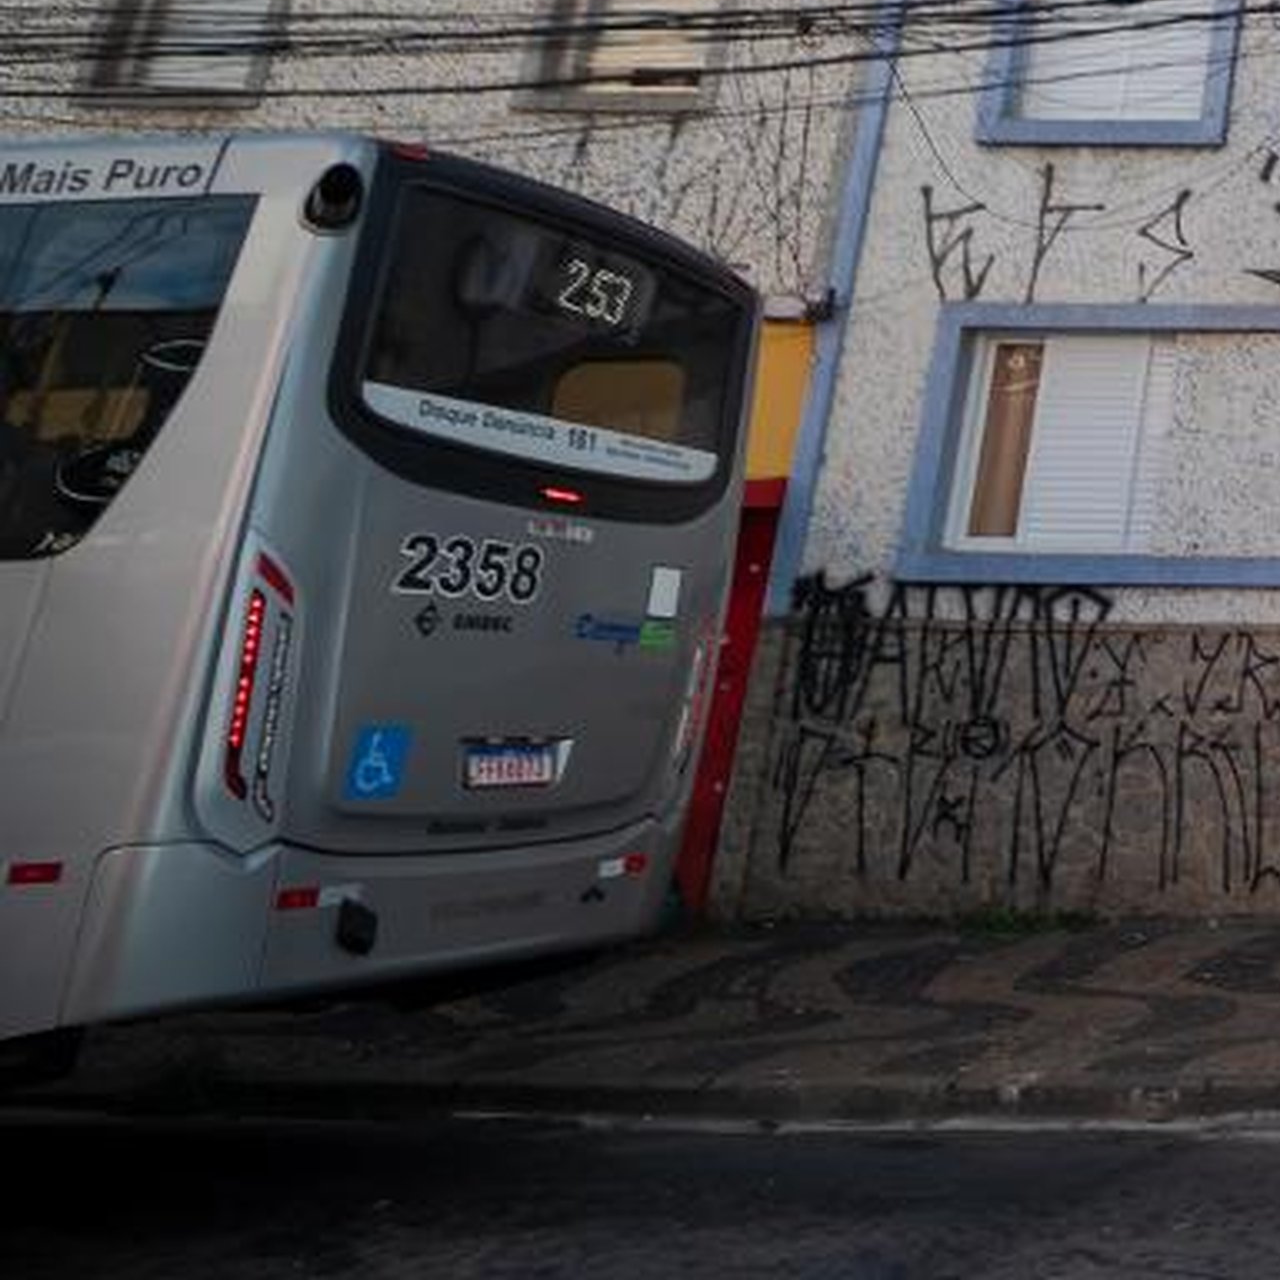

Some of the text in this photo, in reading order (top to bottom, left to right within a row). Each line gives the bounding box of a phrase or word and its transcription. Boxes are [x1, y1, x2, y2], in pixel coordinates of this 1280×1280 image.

[102, 158, 204, 191] Puro
[558, 258, 632, 325] 253
[392, 531, 545, 605] 2358
